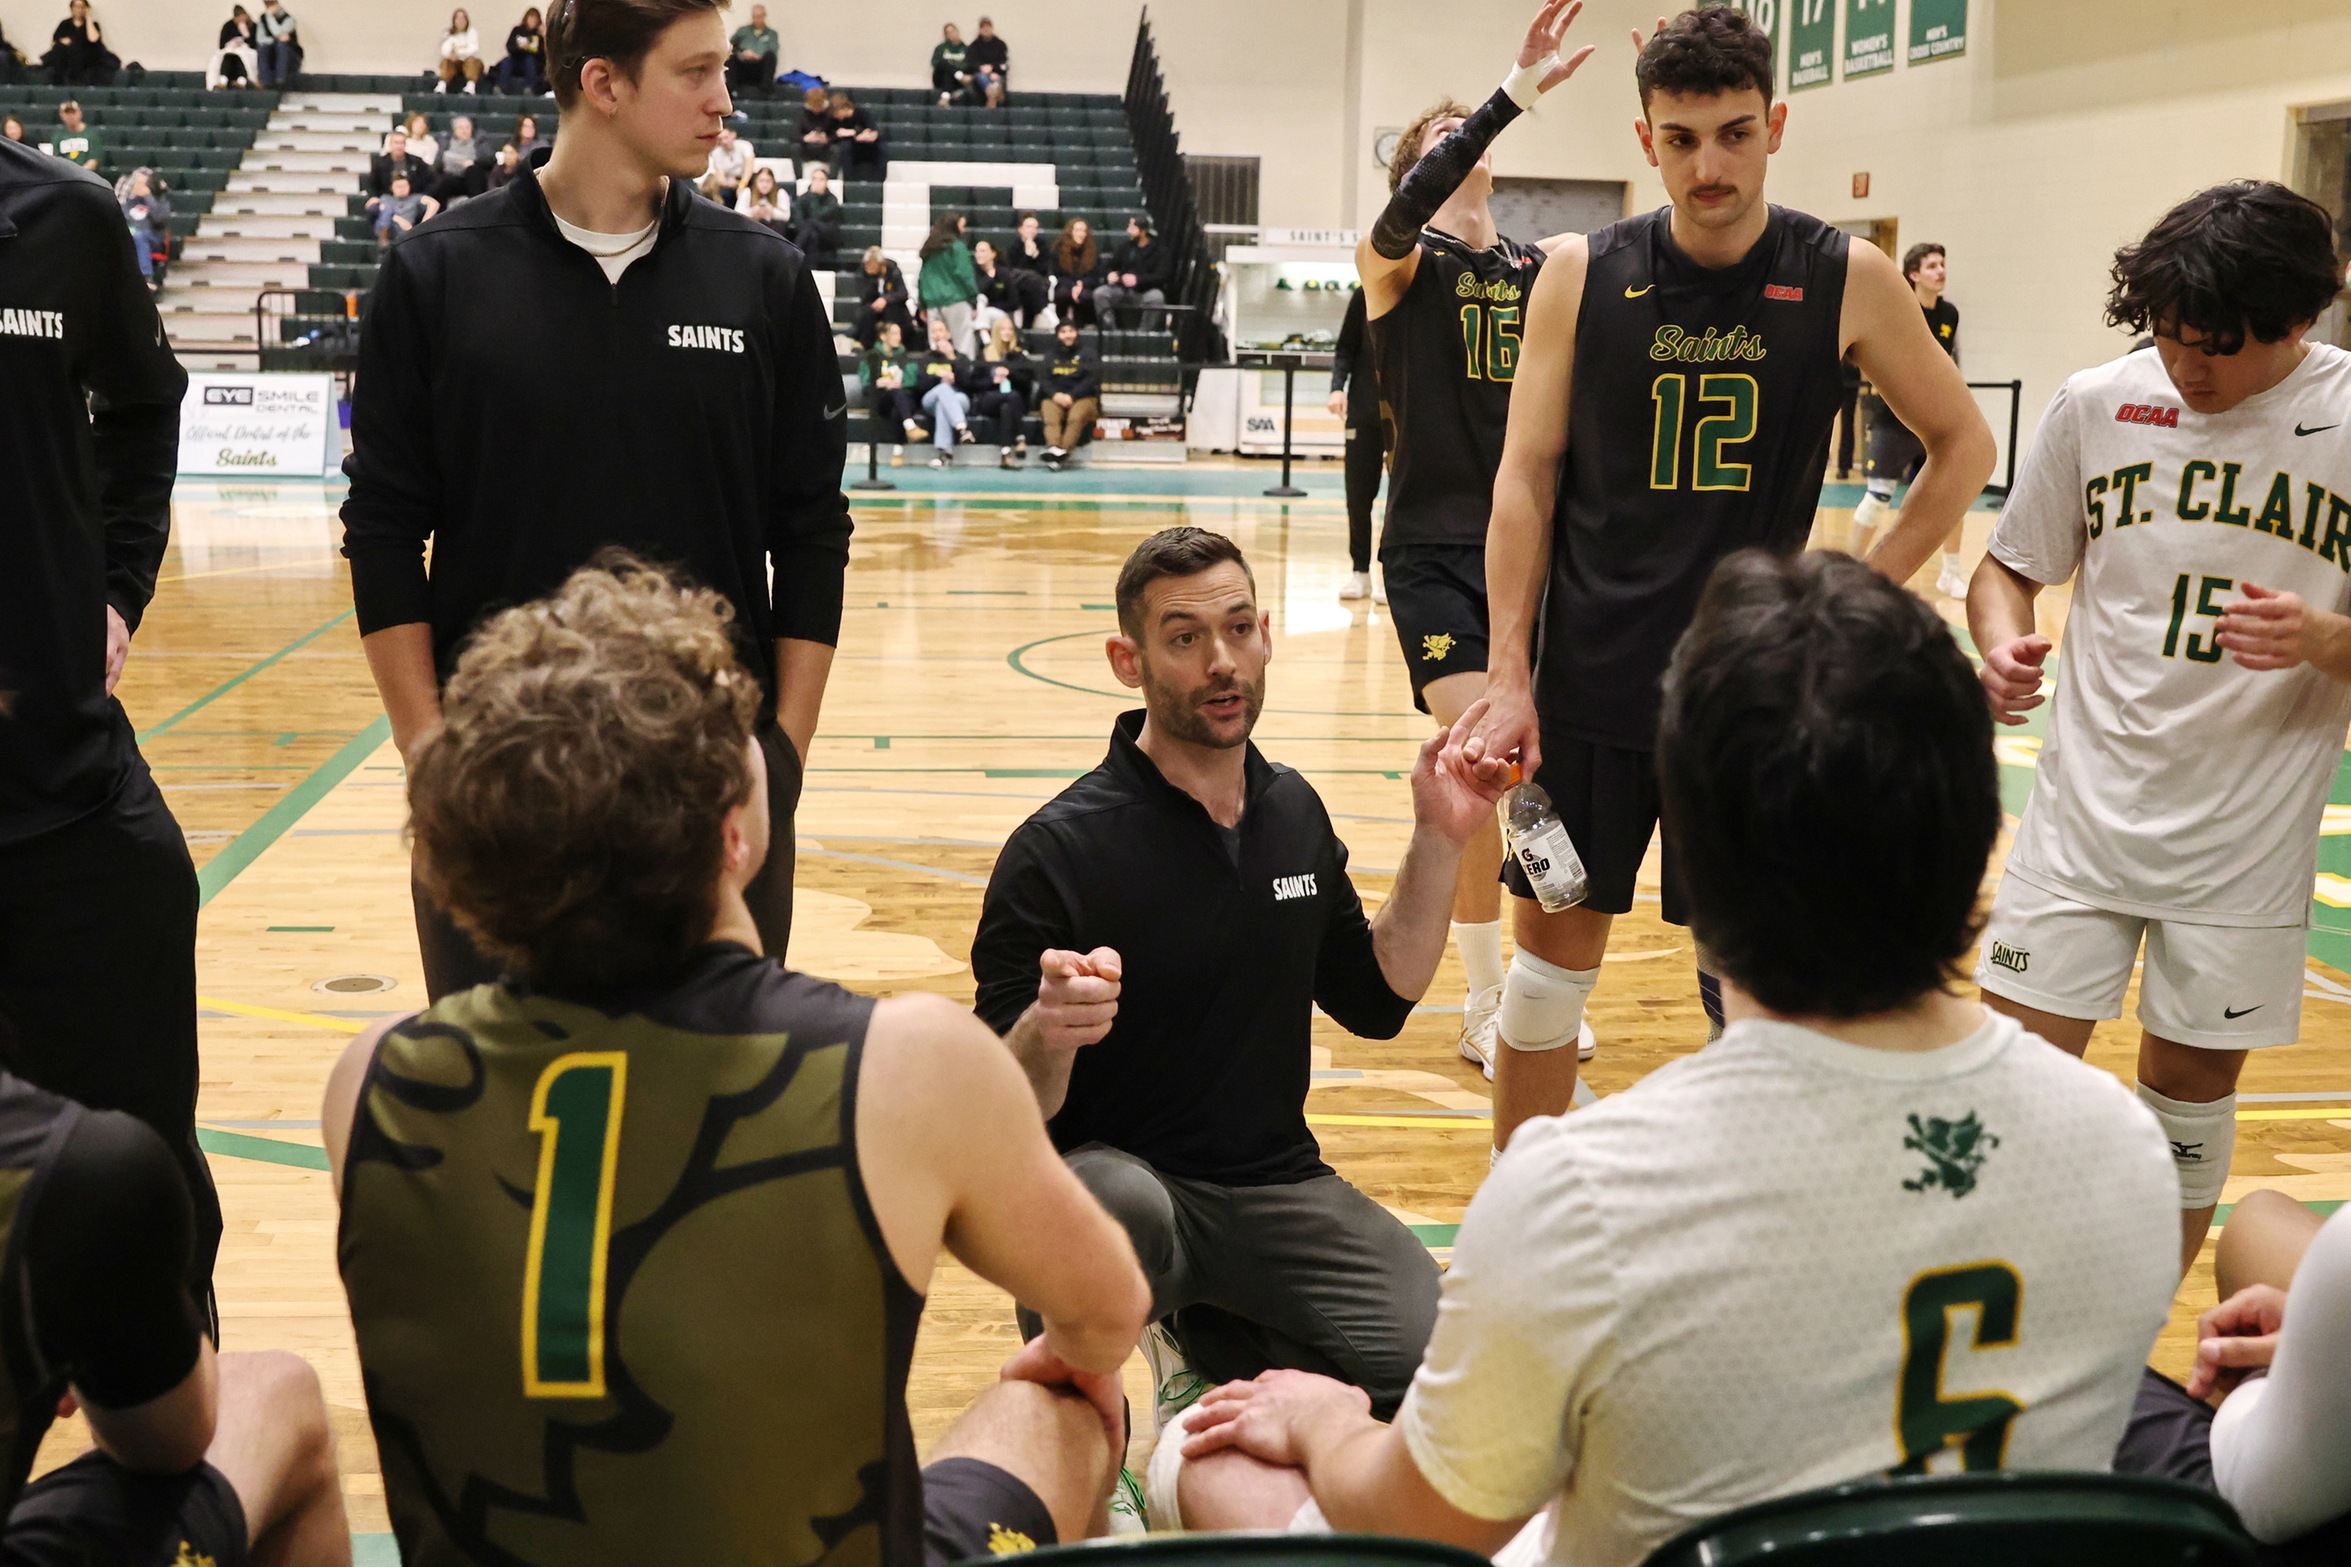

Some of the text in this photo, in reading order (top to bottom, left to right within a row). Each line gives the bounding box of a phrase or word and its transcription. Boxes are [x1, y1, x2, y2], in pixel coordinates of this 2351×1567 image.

[668, 325, 744, 353] SAINTS
[1460, 304, 1522, 382] 16
[1650, 324, 1766, 362] Saints
[206, 388, 319, 403] EYE SMILE
[256, 404, 318, 413] DENTAL
[2115, 404, 2180, 428] OCAA
[1650, 373, 1759, 491] 12
[216, 448, 277, 467] Saints
[2085, 460, 2154, 541] ST.
[2161, 572, 2234, 665] 15
[1521, 847, 1534, 862] G
[1272, 873, 1318, 901] SAINTS
[1991, 941, 2030, 972] SAINTS
[521, 1051, 628, 1397] 1
[1883, 1258, 2028, 1478] 6
